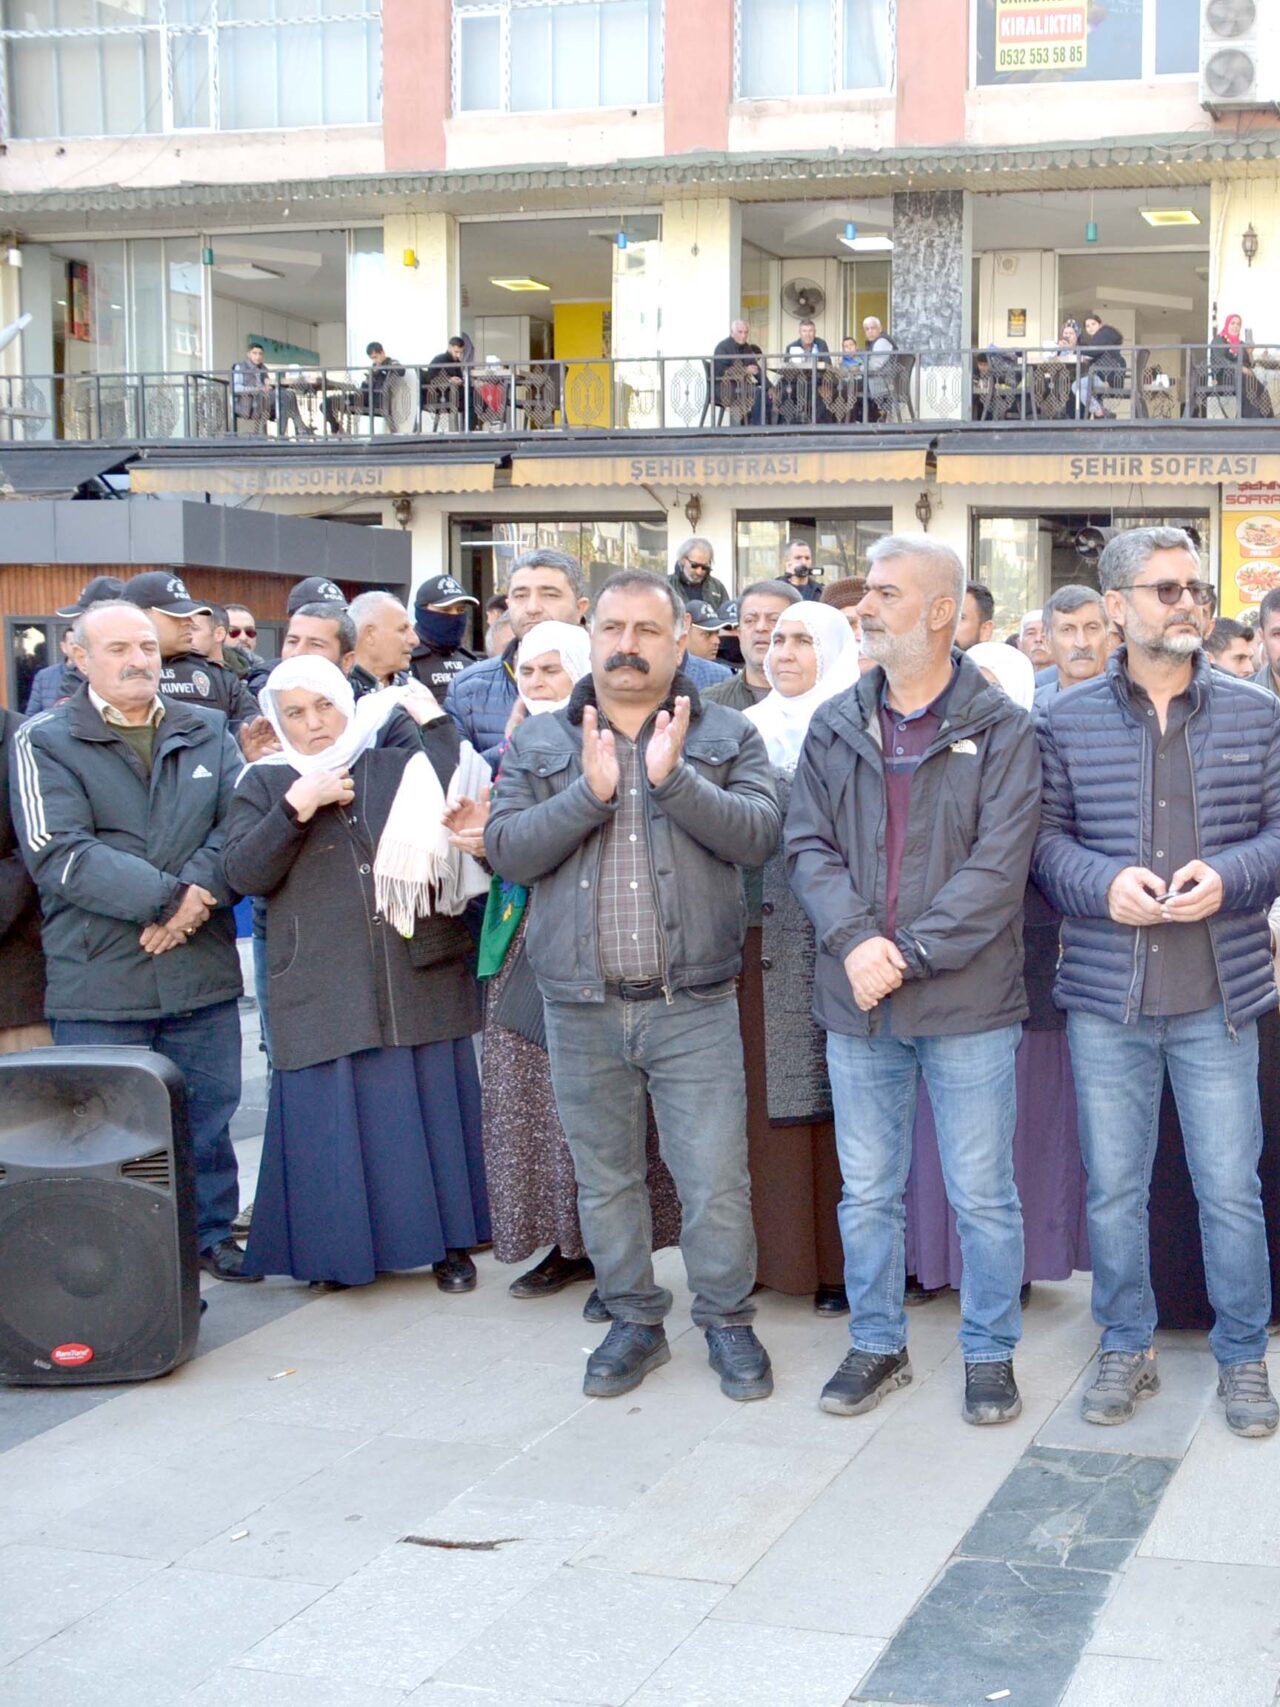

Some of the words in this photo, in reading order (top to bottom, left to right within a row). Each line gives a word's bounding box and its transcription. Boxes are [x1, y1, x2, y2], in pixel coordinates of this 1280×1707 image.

[1001, 13, 1083, 37] KIRALIKTIR
[1000, 48, 1026, 66] 0532
[1029, 47, 1049, 64] 553
[1053, 46, 1066, 63] 58
[1069, 45, 1083, 62] 85
[298, 467, 384, 487] SOFRASI
[631, 459, 697, 480] ŞEHİR
[702, 456, 799, 477] SOFRASI
[1070, 457, 1143, 479] ŞEHİR
[1149, 456, 1257, 476] SOFRASI
[161, 682, 196, 694] KUVVET
